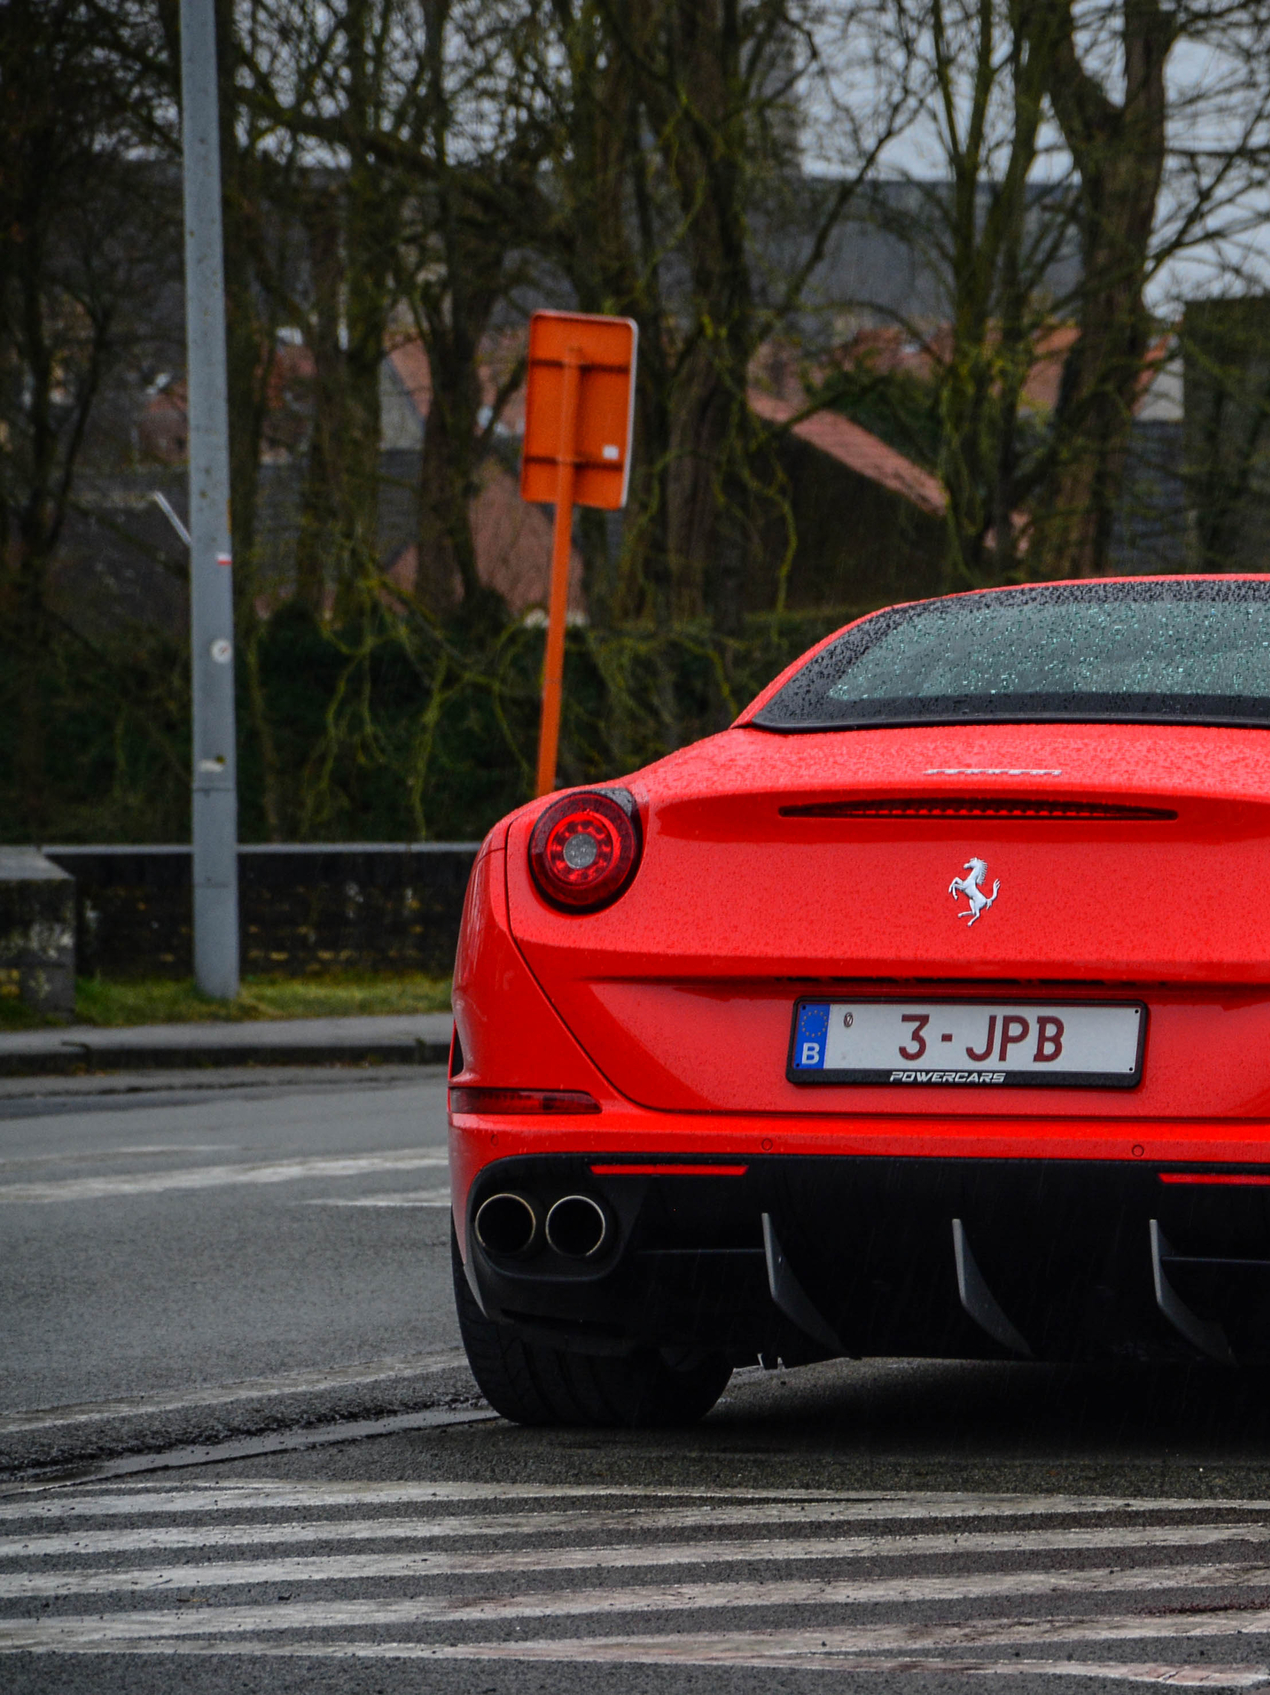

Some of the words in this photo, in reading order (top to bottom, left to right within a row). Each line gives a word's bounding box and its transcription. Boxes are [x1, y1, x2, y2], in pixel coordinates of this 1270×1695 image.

[898, 1013, 1065, 1063] 3-JPB
[801, 1042, 820, 1065] B
[889, 1070, 1006, 1084] POWERCARS
